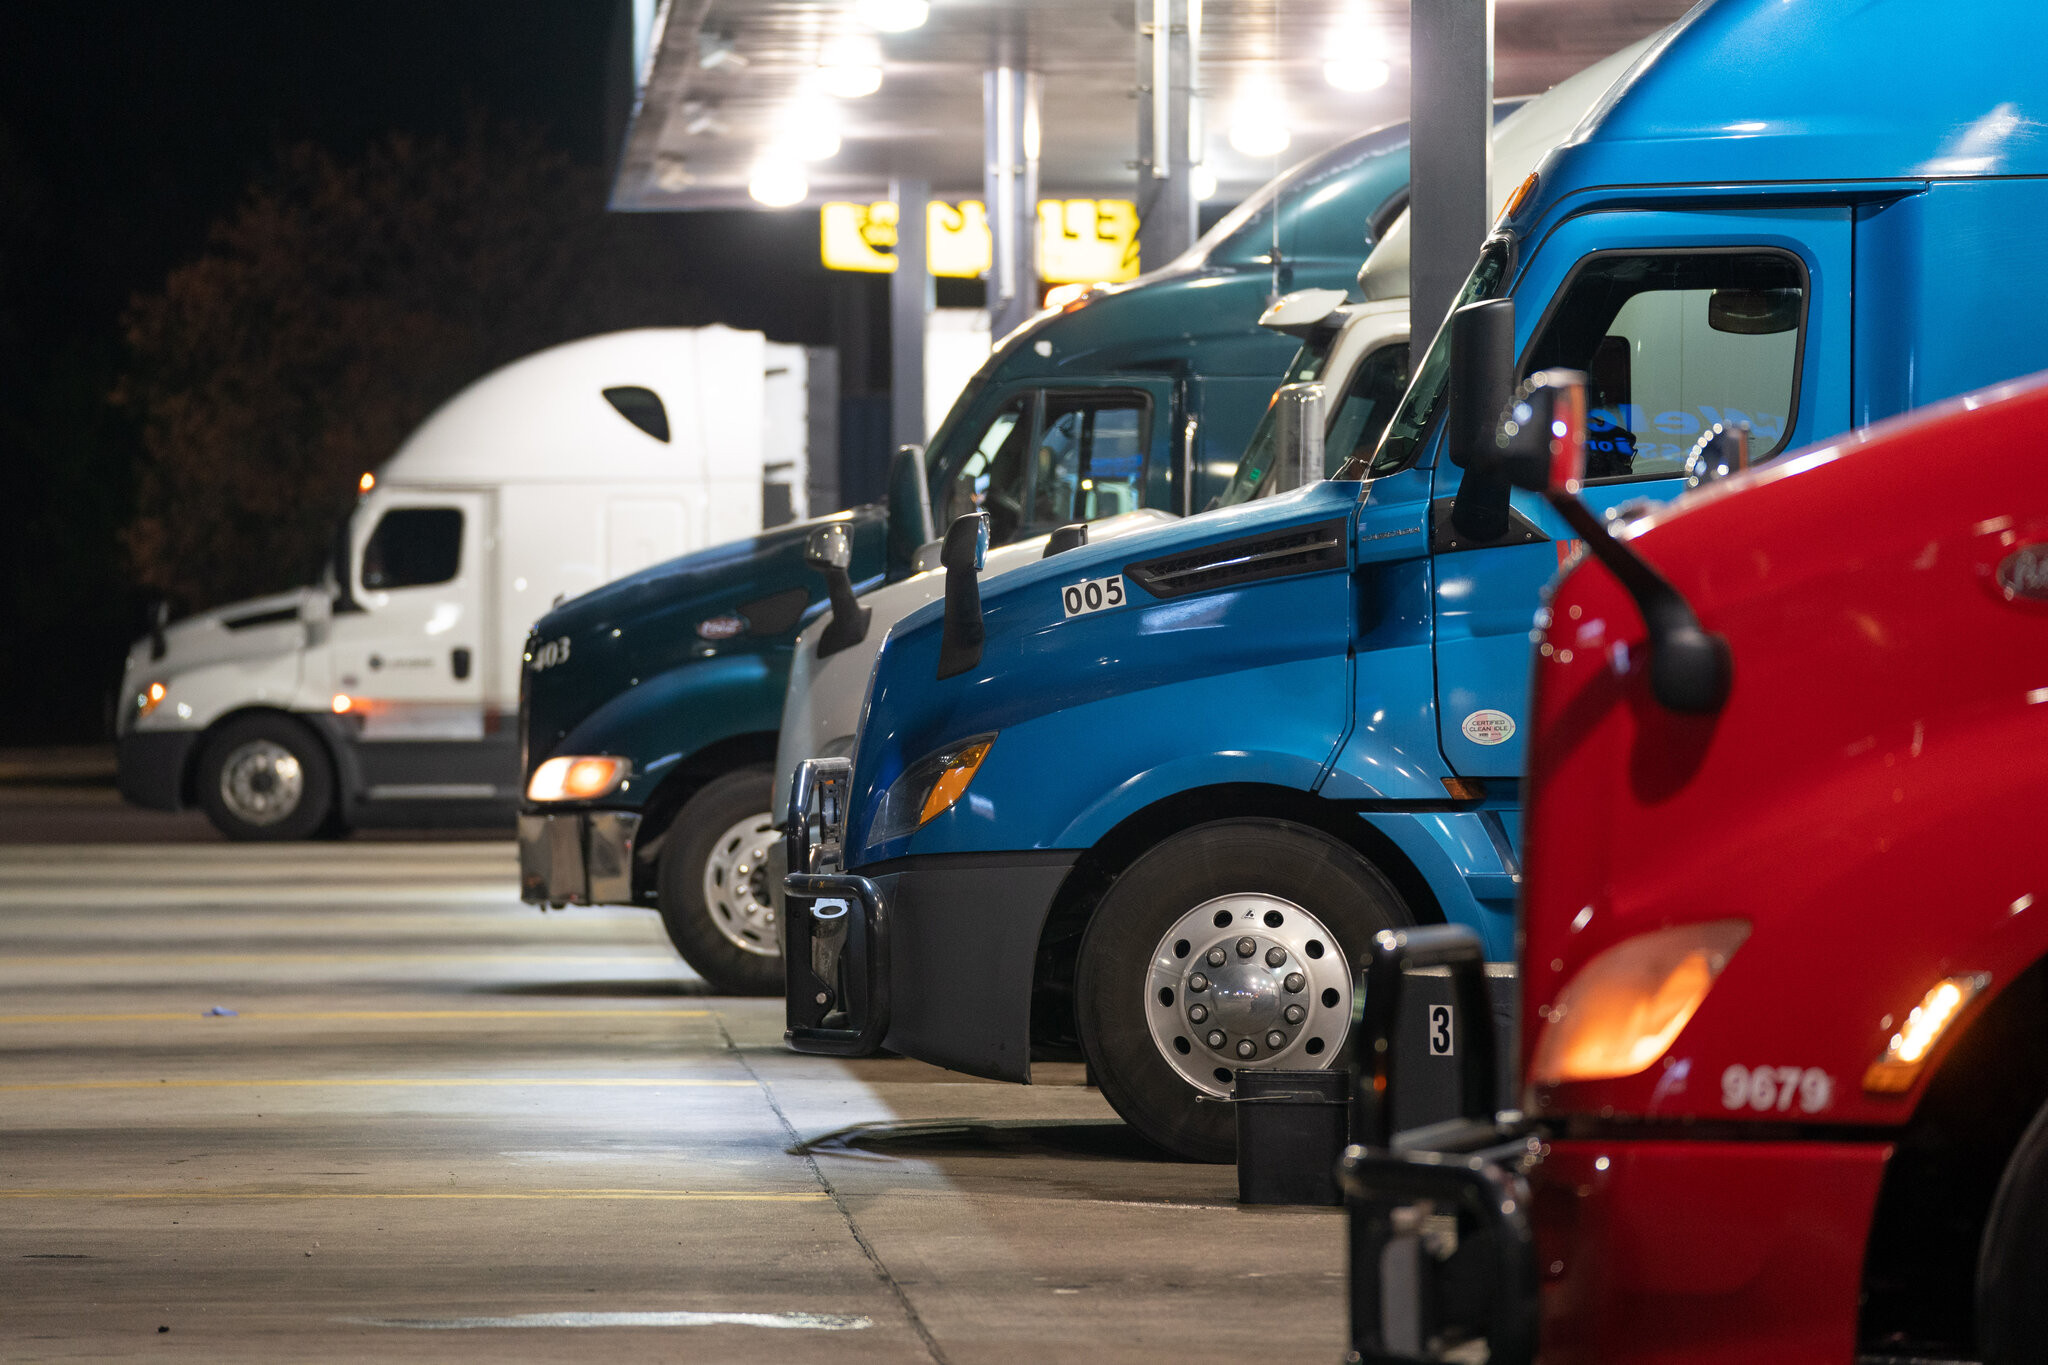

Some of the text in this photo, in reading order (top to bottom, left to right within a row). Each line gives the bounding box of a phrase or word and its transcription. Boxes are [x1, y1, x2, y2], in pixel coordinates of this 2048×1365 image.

[1065, 577, 1123, 615] 005
[1433, 1006, 1450, 1053] 3
[1721, 1064, 1832, 1114] 9679
